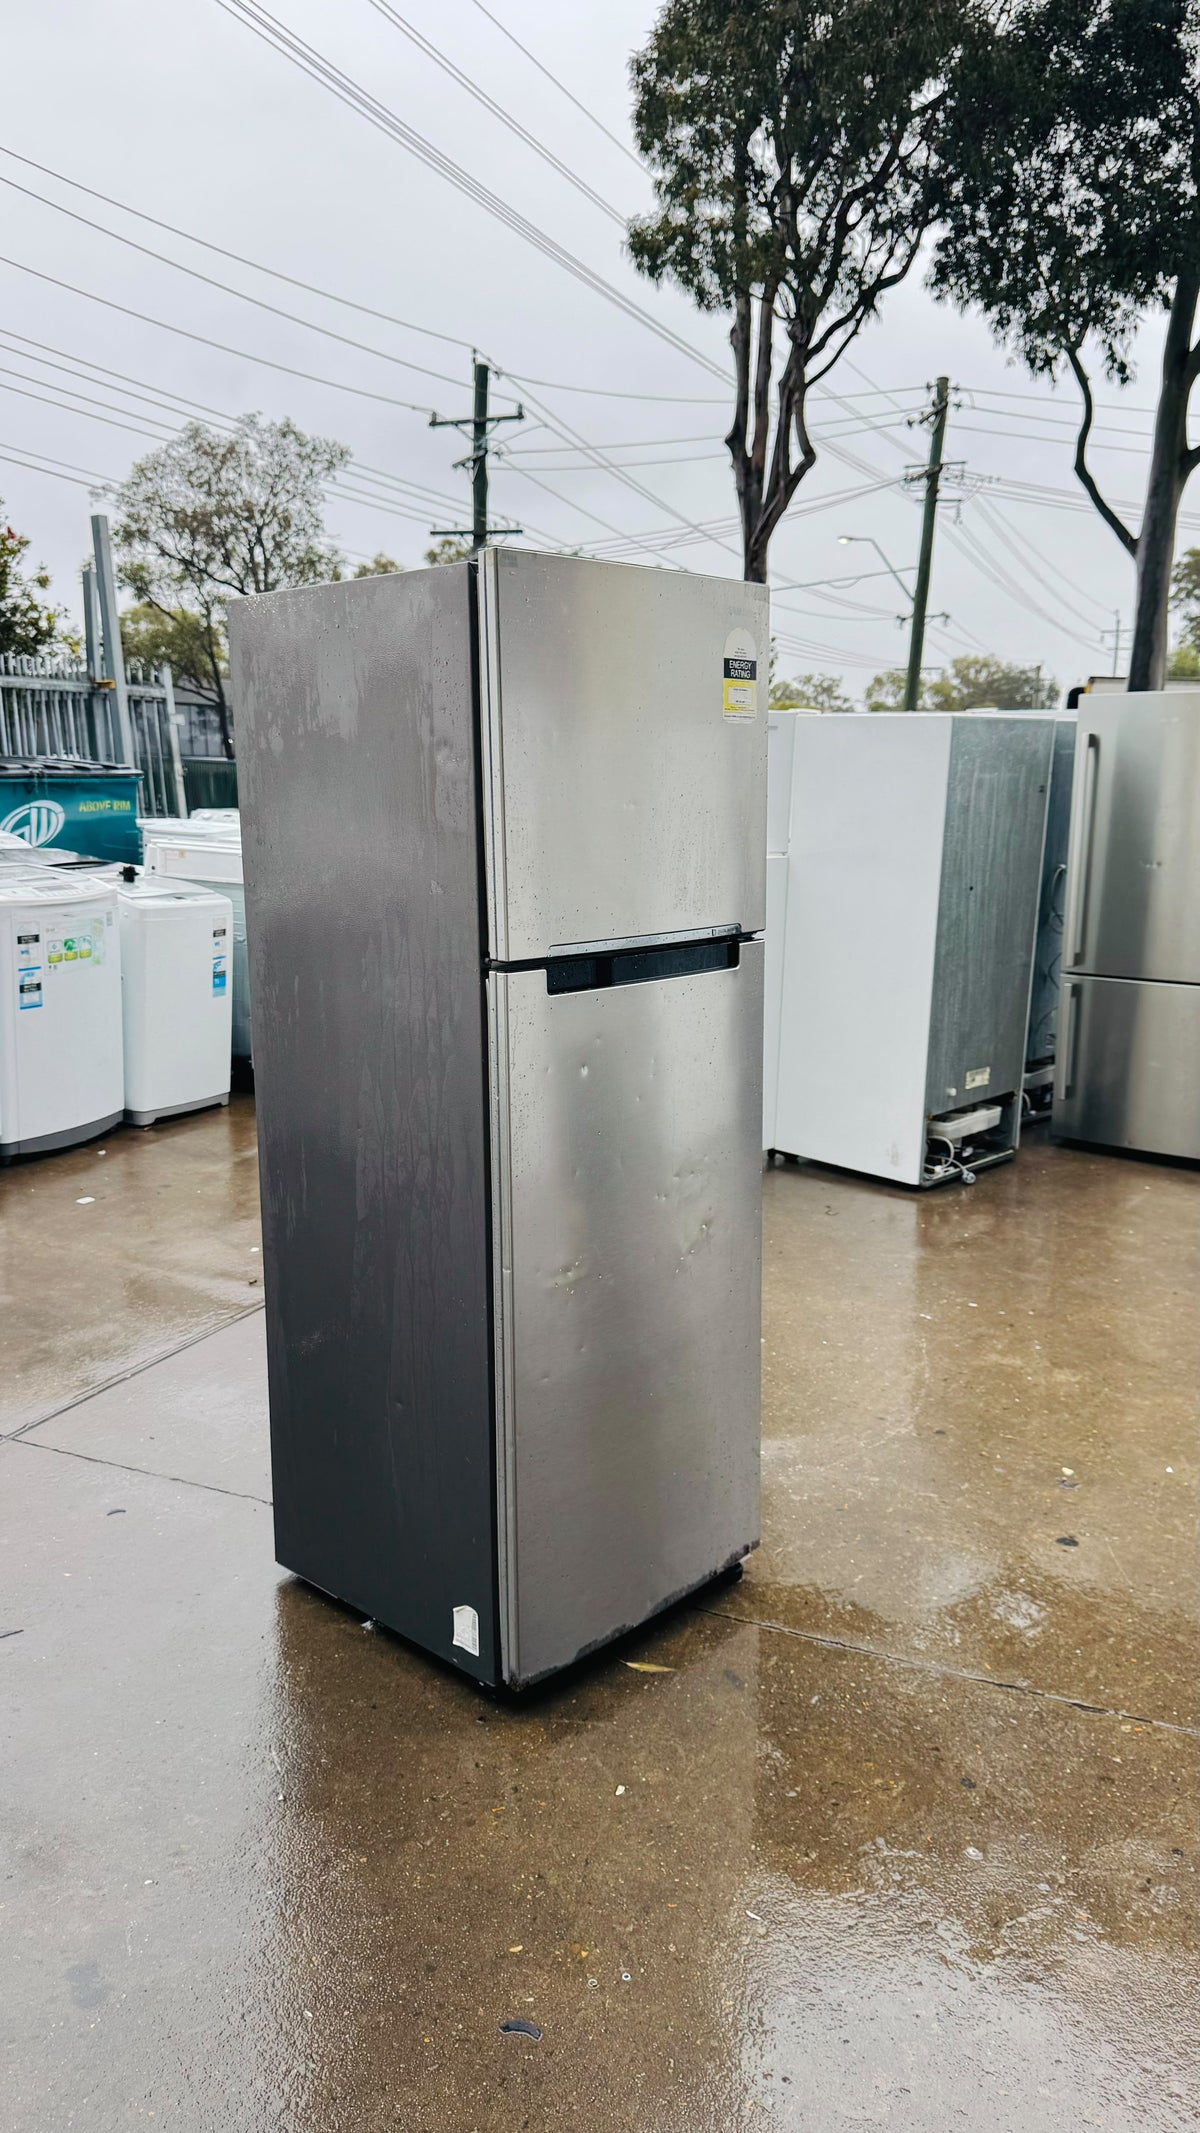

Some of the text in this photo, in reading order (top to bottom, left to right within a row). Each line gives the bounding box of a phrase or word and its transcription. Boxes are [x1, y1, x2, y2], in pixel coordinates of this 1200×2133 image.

[729, 660, 752, 670] ENERGY
[730, 670, 751, 678] RATING
[79, 800, 111, 812] ABOVE
